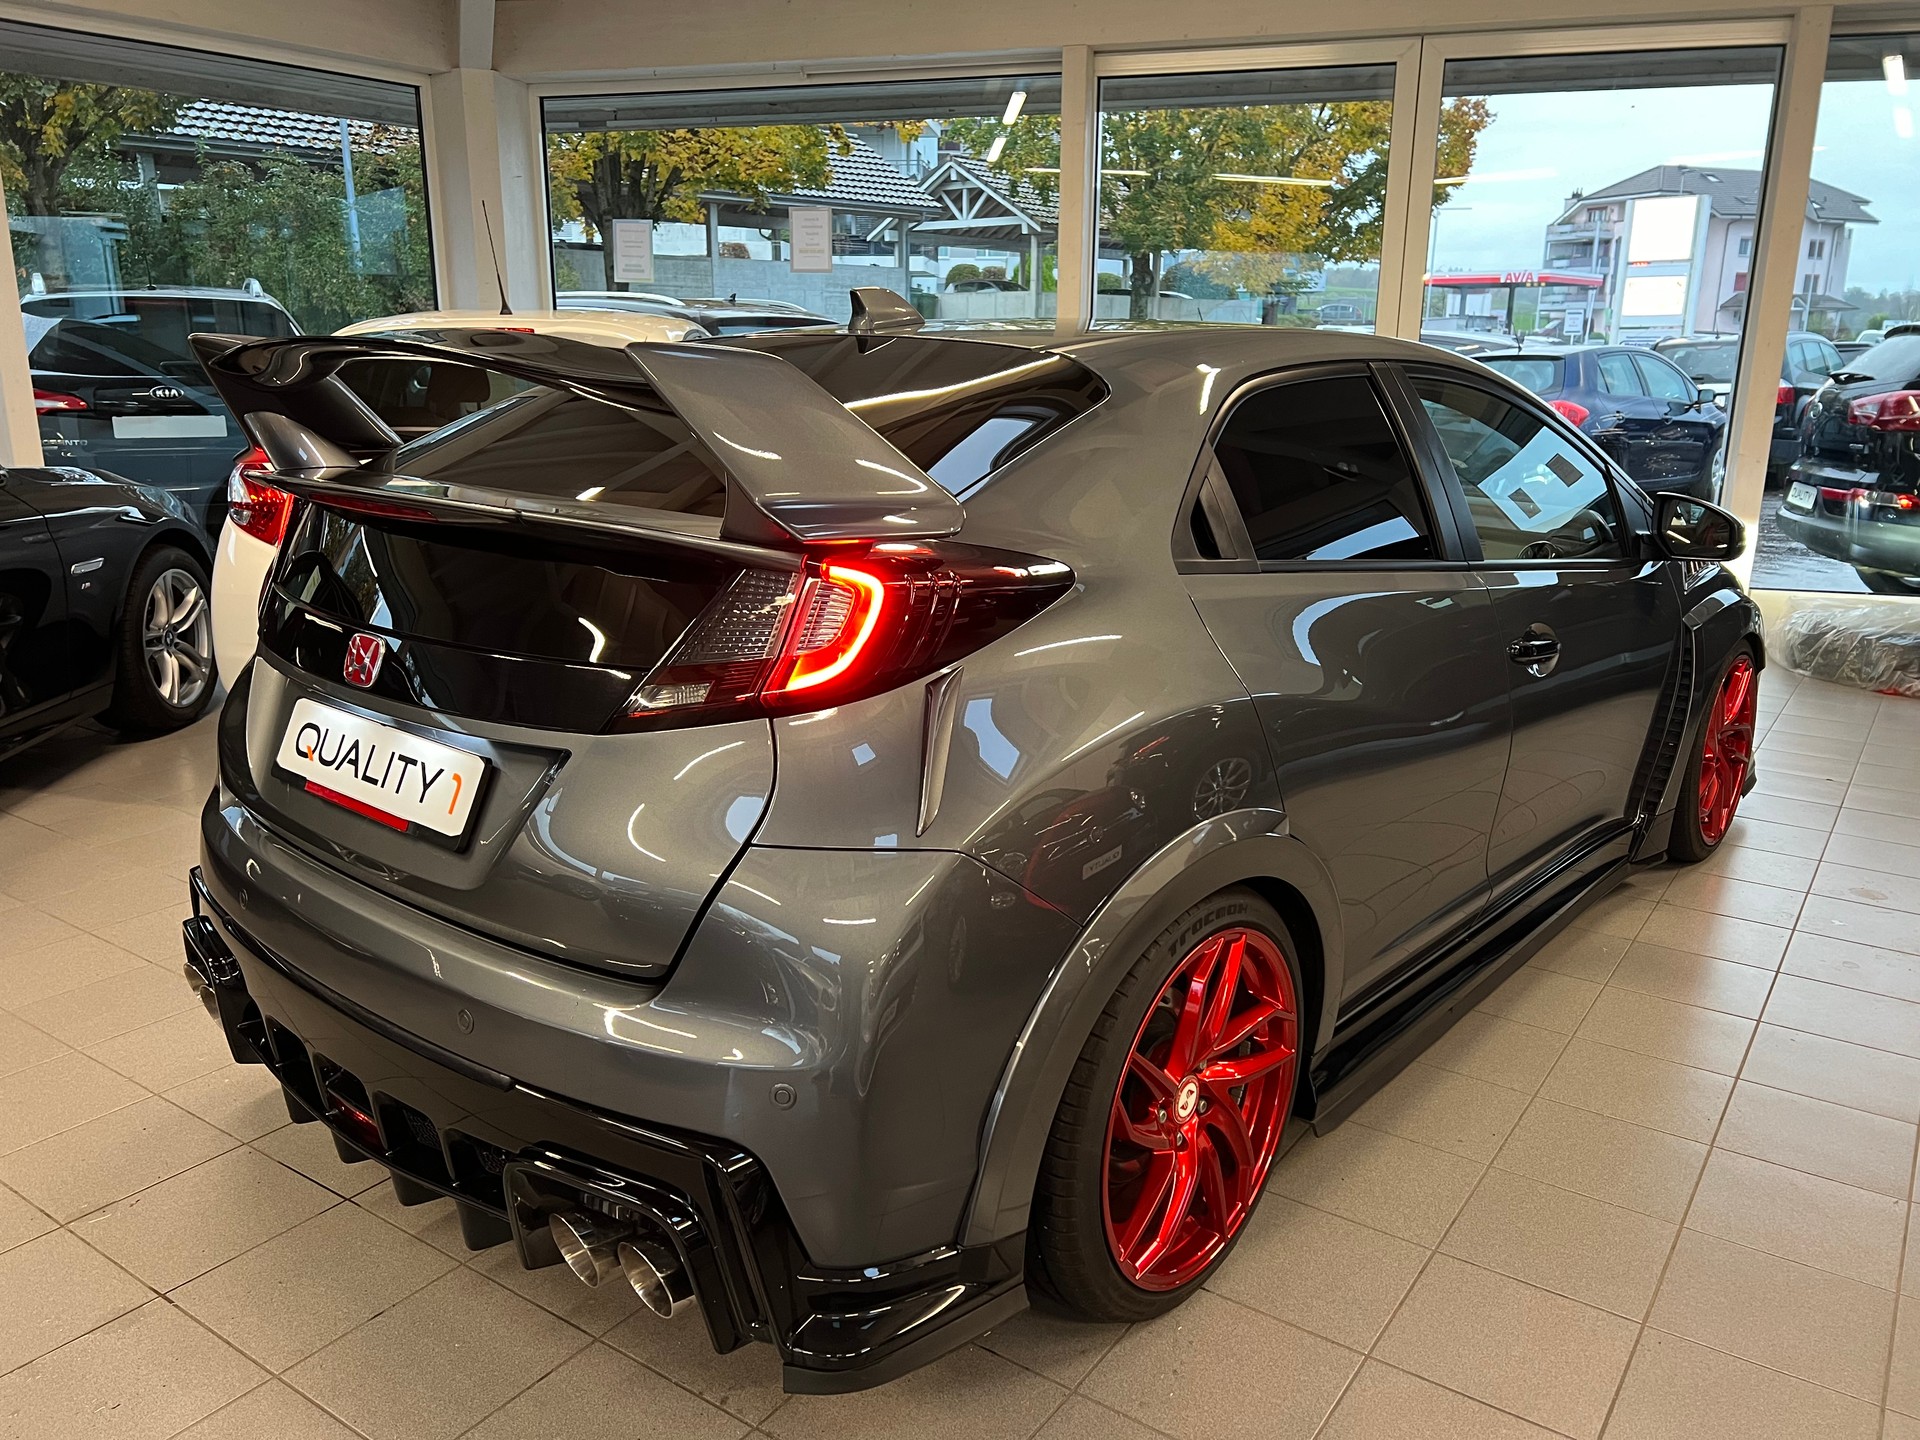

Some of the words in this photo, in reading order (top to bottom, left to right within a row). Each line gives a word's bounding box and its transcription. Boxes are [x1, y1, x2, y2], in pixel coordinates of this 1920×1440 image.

[1504, 270, 1534, 283] AVIA
[155, 389, 179, 399] KIA
[42, 439, 88, 447] ORENTO
[295, 722, 445, 804] QUALITY
[447, 772, 462, 816] 1
